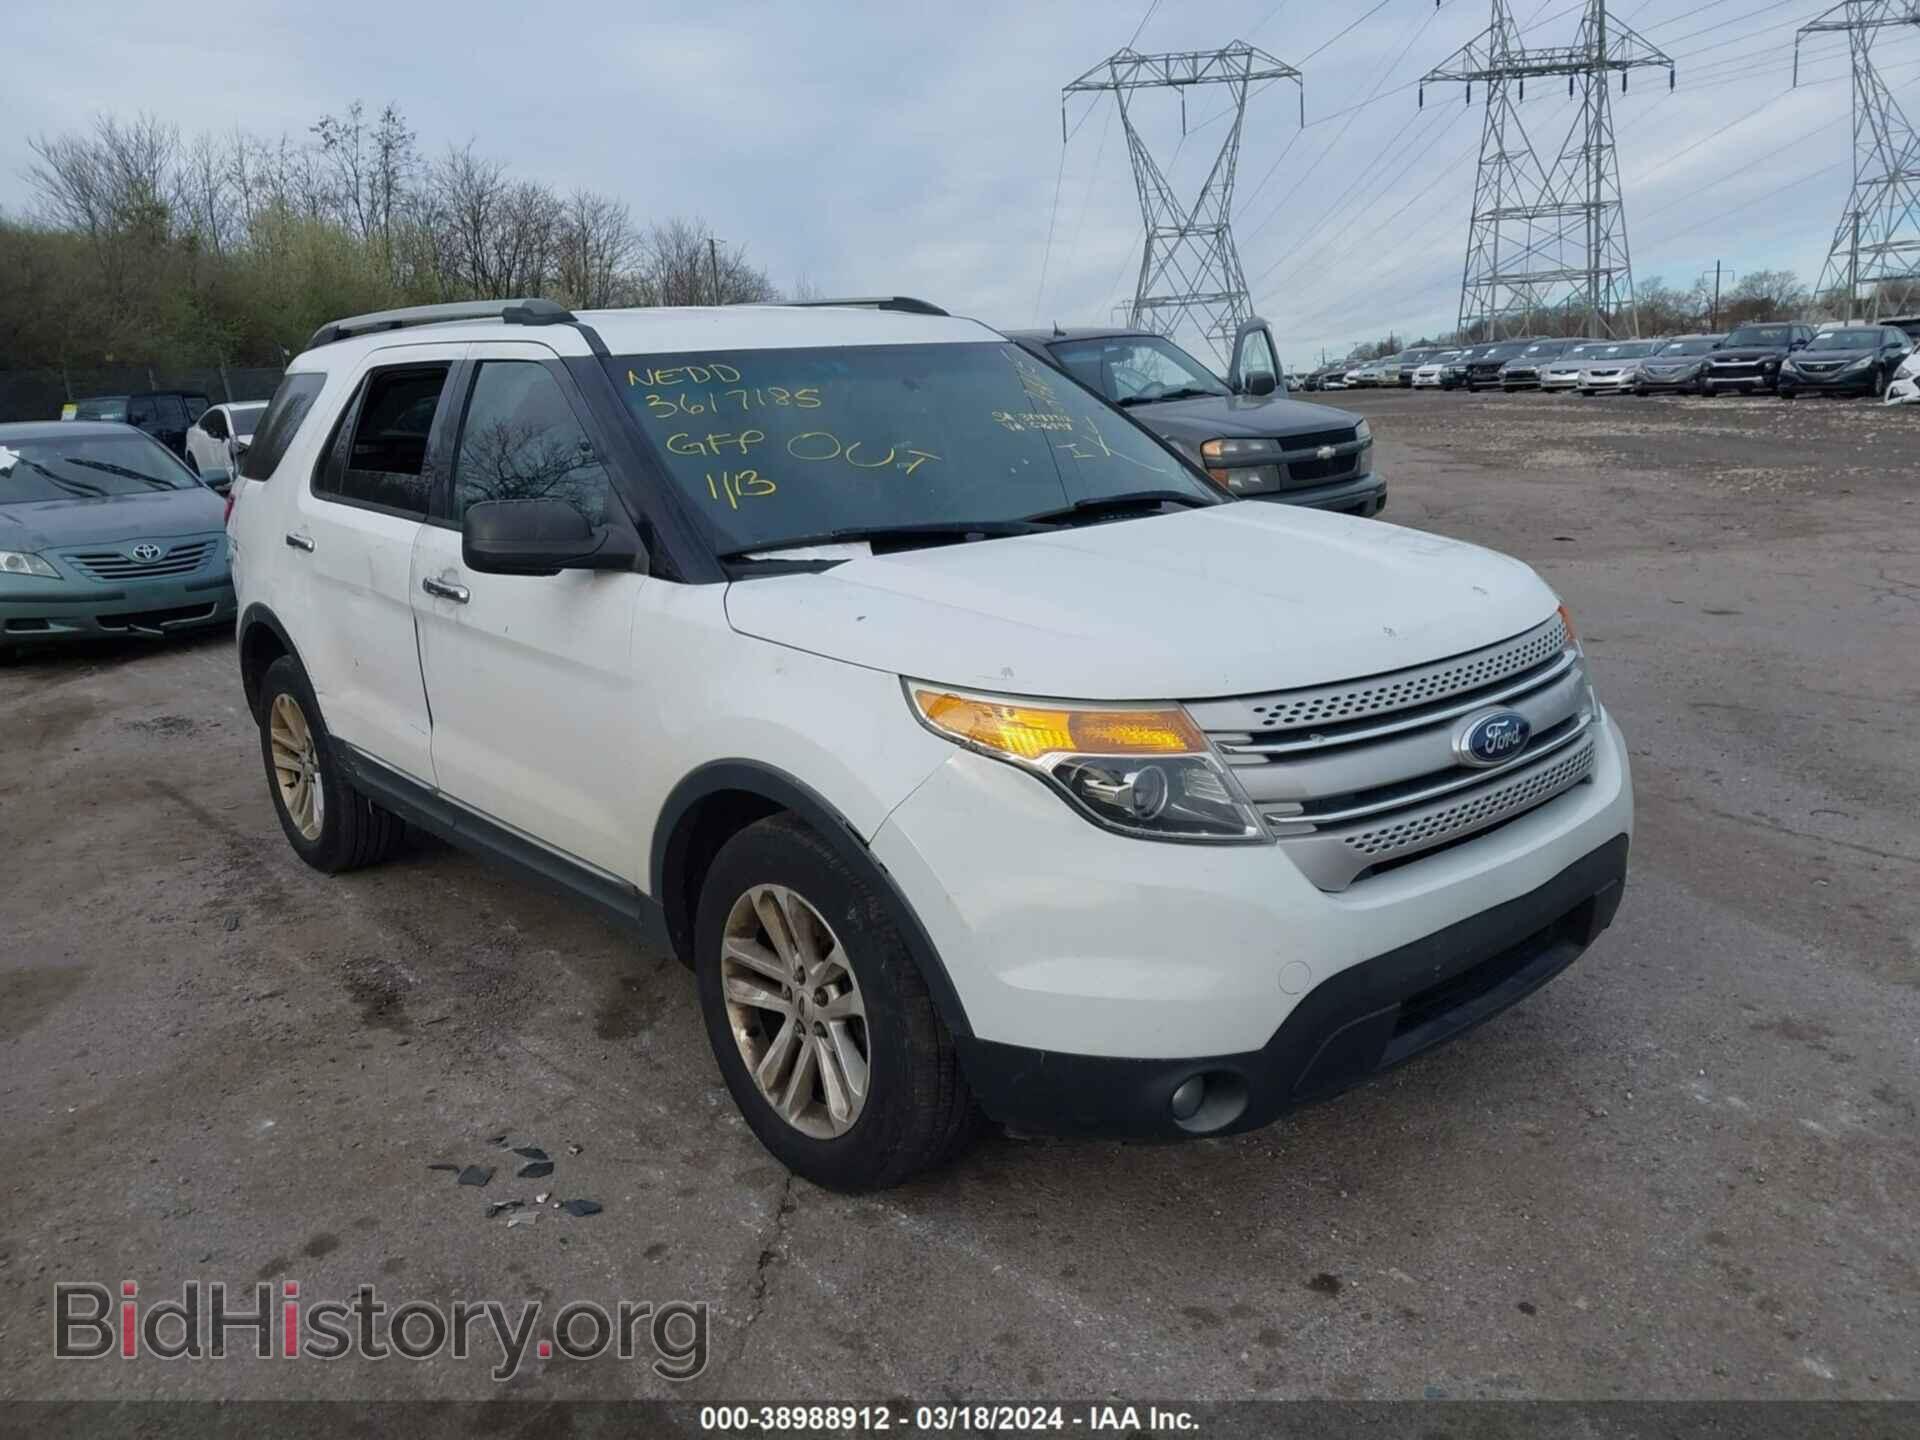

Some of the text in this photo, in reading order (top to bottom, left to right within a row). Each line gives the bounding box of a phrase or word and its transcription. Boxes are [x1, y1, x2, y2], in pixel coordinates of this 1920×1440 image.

[627, 364, 742, 386] NEDD
[645, 387, 823, 418] 3617185
[786, 431, 943, 475] OUT
[1485, 720, 1521, 754] Ford
